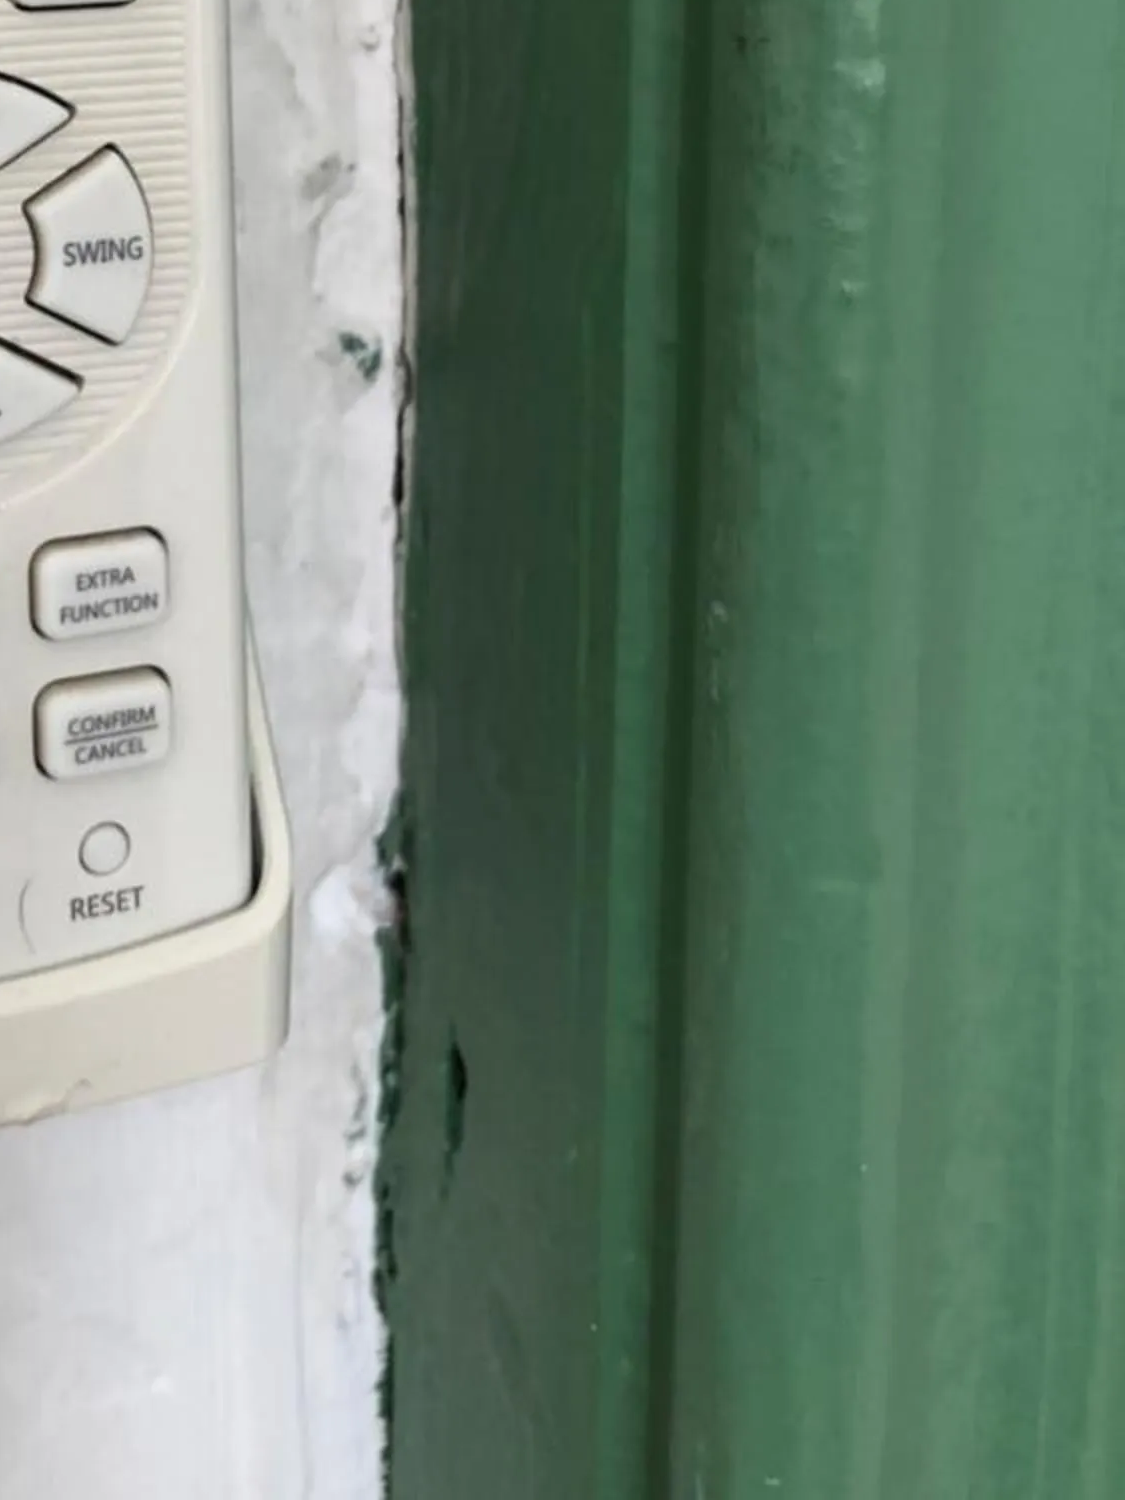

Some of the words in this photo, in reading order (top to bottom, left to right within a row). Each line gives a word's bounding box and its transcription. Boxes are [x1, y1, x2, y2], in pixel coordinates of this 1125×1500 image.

[62, 236, 144, 267] SWING
[75, 566, 135, 592] EXTRA
[59, 594, 159, 625] FUNCTION
[67, 706, 156, 736] CONFIRM
[74, 738, 147, 765] CANCEL
[69, 887, 144, 921] RESET
